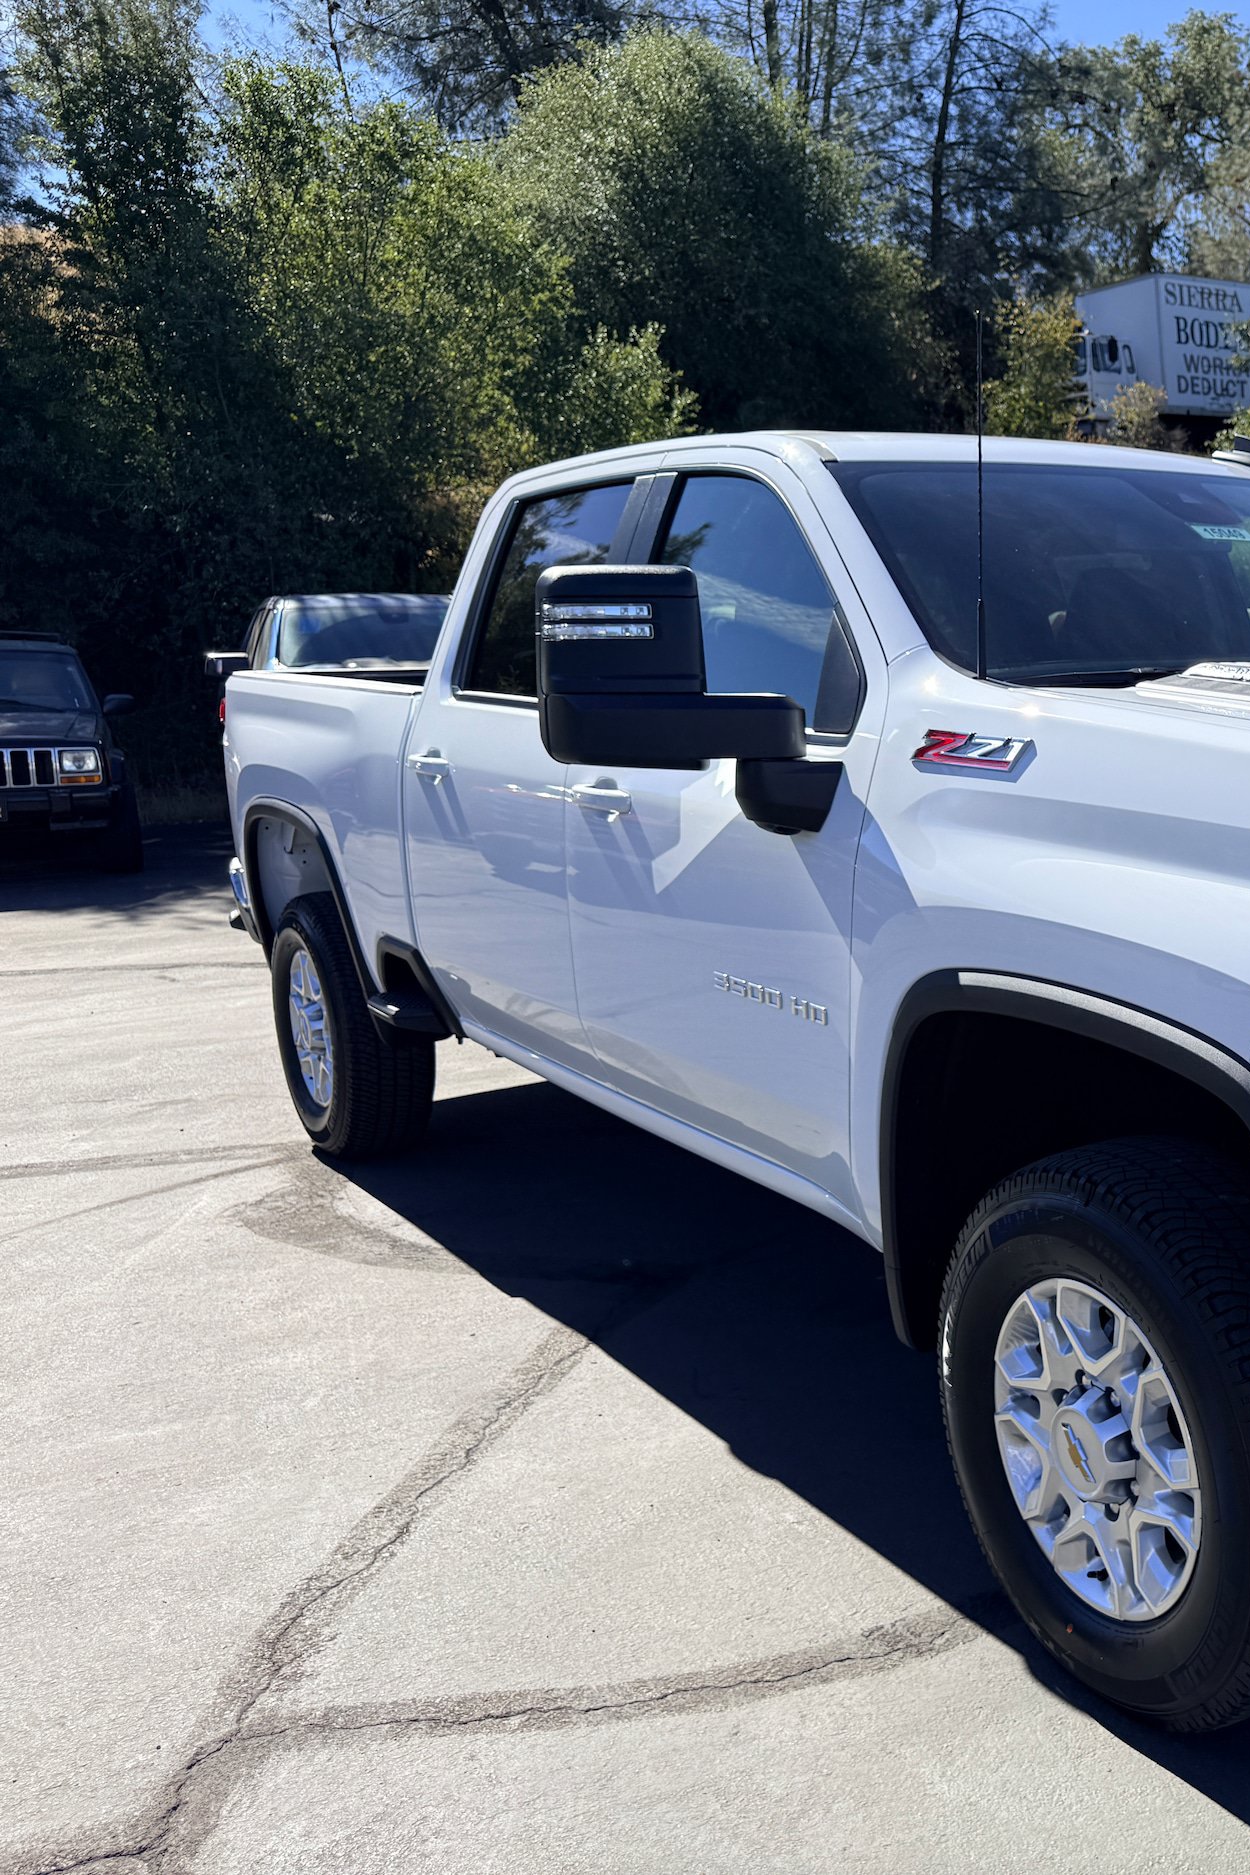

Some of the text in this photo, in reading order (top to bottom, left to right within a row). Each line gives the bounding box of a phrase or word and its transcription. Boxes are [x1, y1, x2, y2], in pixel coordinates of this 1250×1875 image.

[1164, 282, 1243, 313] SIERRA
[910, 729, 1033, 772] Z71
[713, 970, 828, 1026] 3500 HD
